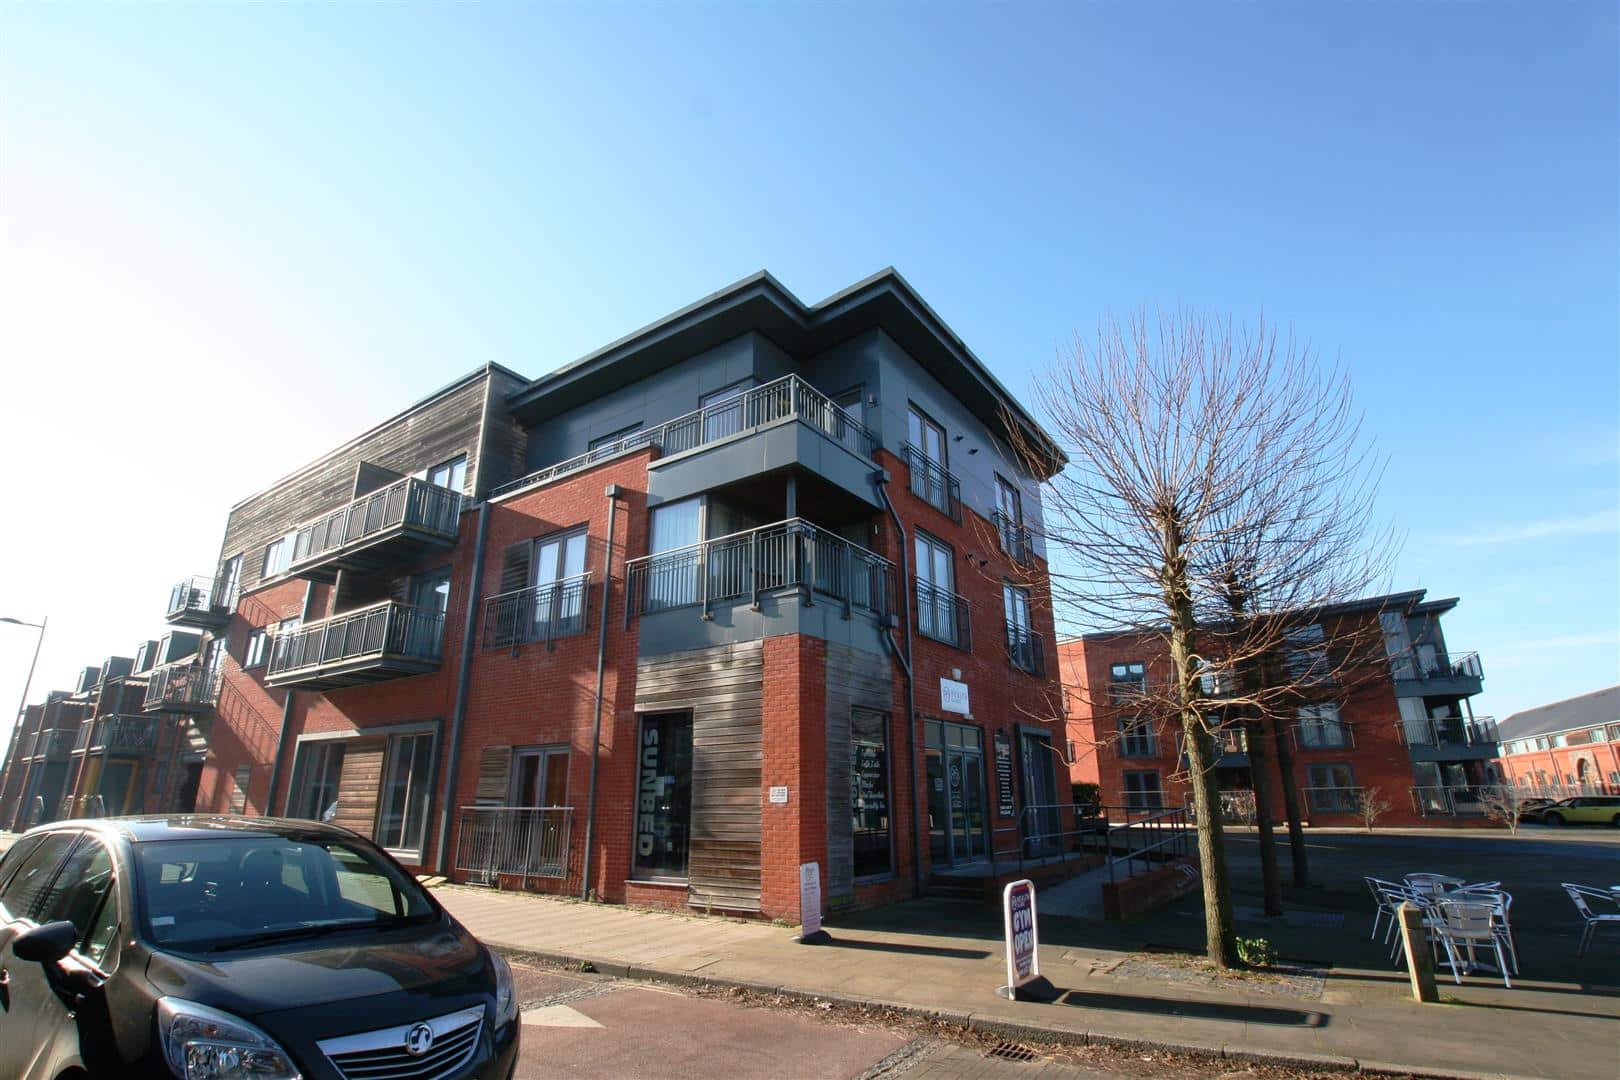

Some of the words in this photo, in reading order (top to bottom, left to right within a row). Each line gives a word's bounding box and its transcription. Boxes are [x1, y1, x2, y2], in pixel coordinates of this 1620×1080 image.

[639, 728, 659, 857] SUNBED
[1014, 908, 1032, 933] GYM
[1015, 929, 1034, 955] OPEN
